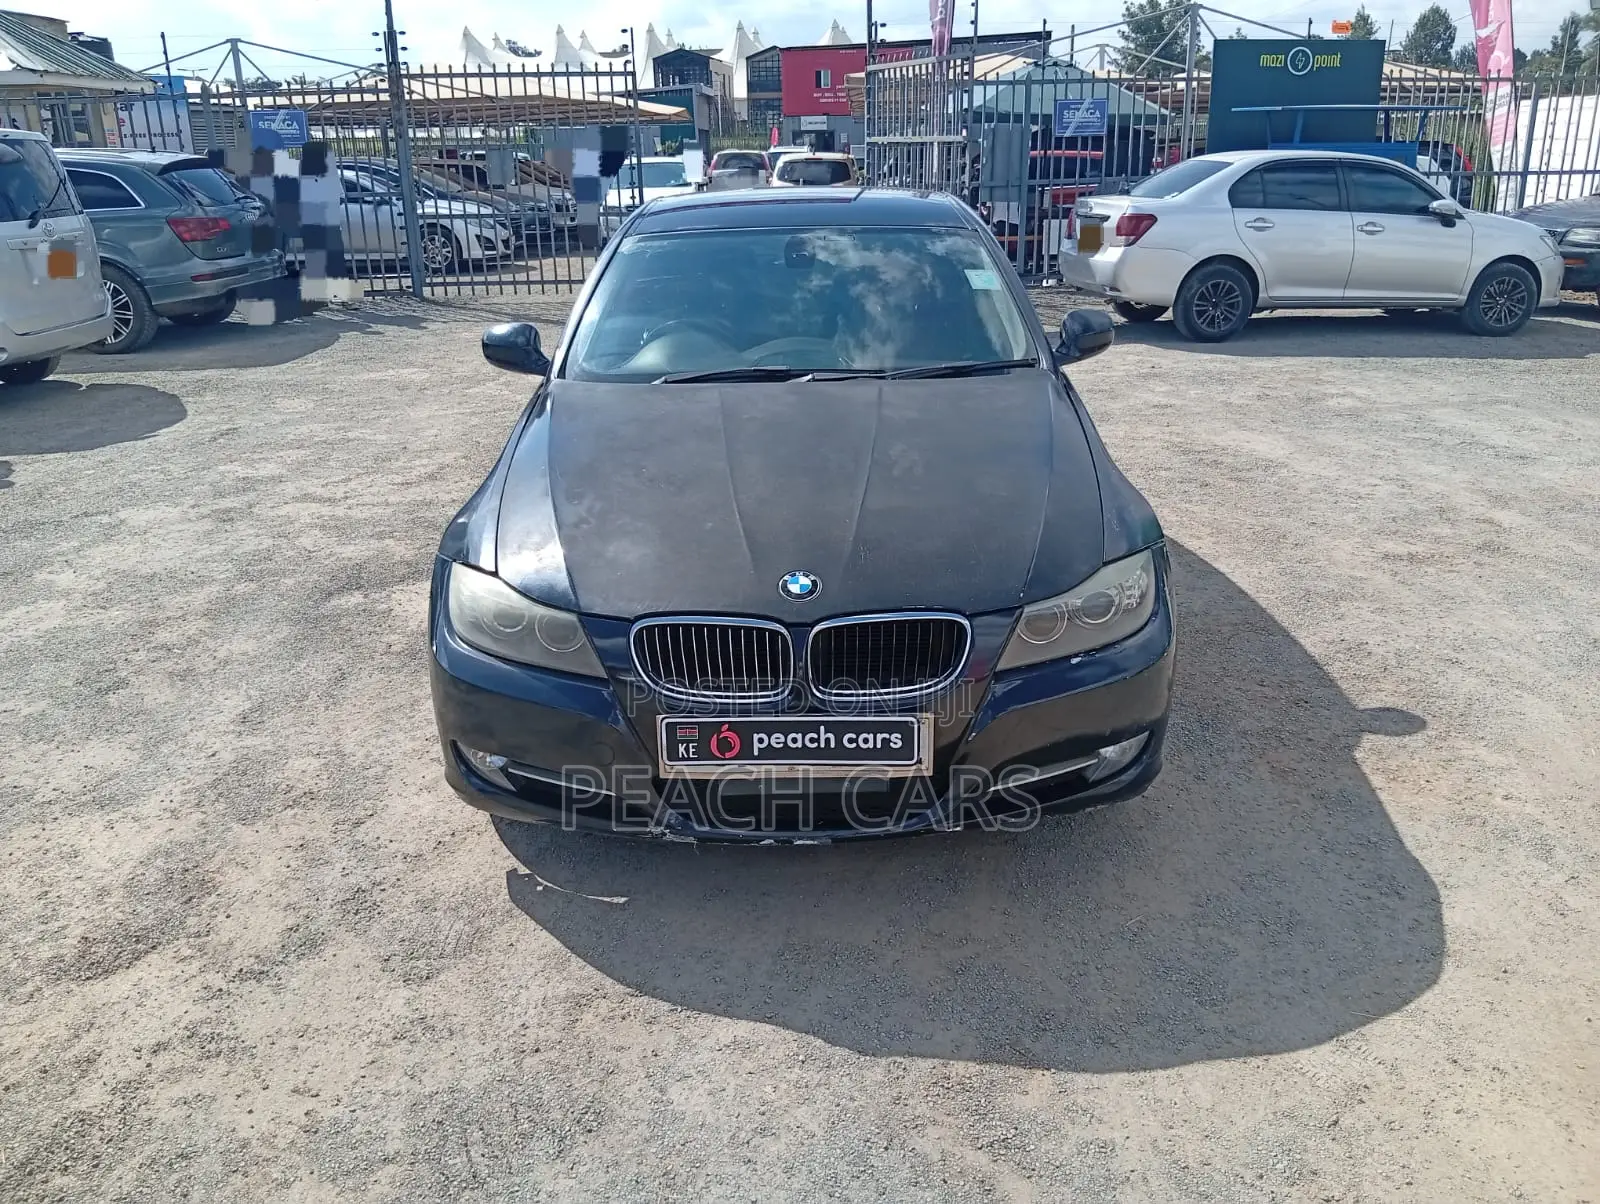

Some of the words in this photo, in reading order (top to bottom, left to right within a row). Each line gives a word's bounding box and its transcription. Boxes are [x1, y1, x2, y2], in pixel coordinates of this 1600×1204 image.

[1313, 52, 1341, 71] point
[1063, 109, 1100, 118] SEACA
[753, 725, 836, 756] peach
[842, 732, 903, 749] cars
[678, 742, 699, 759] KE
